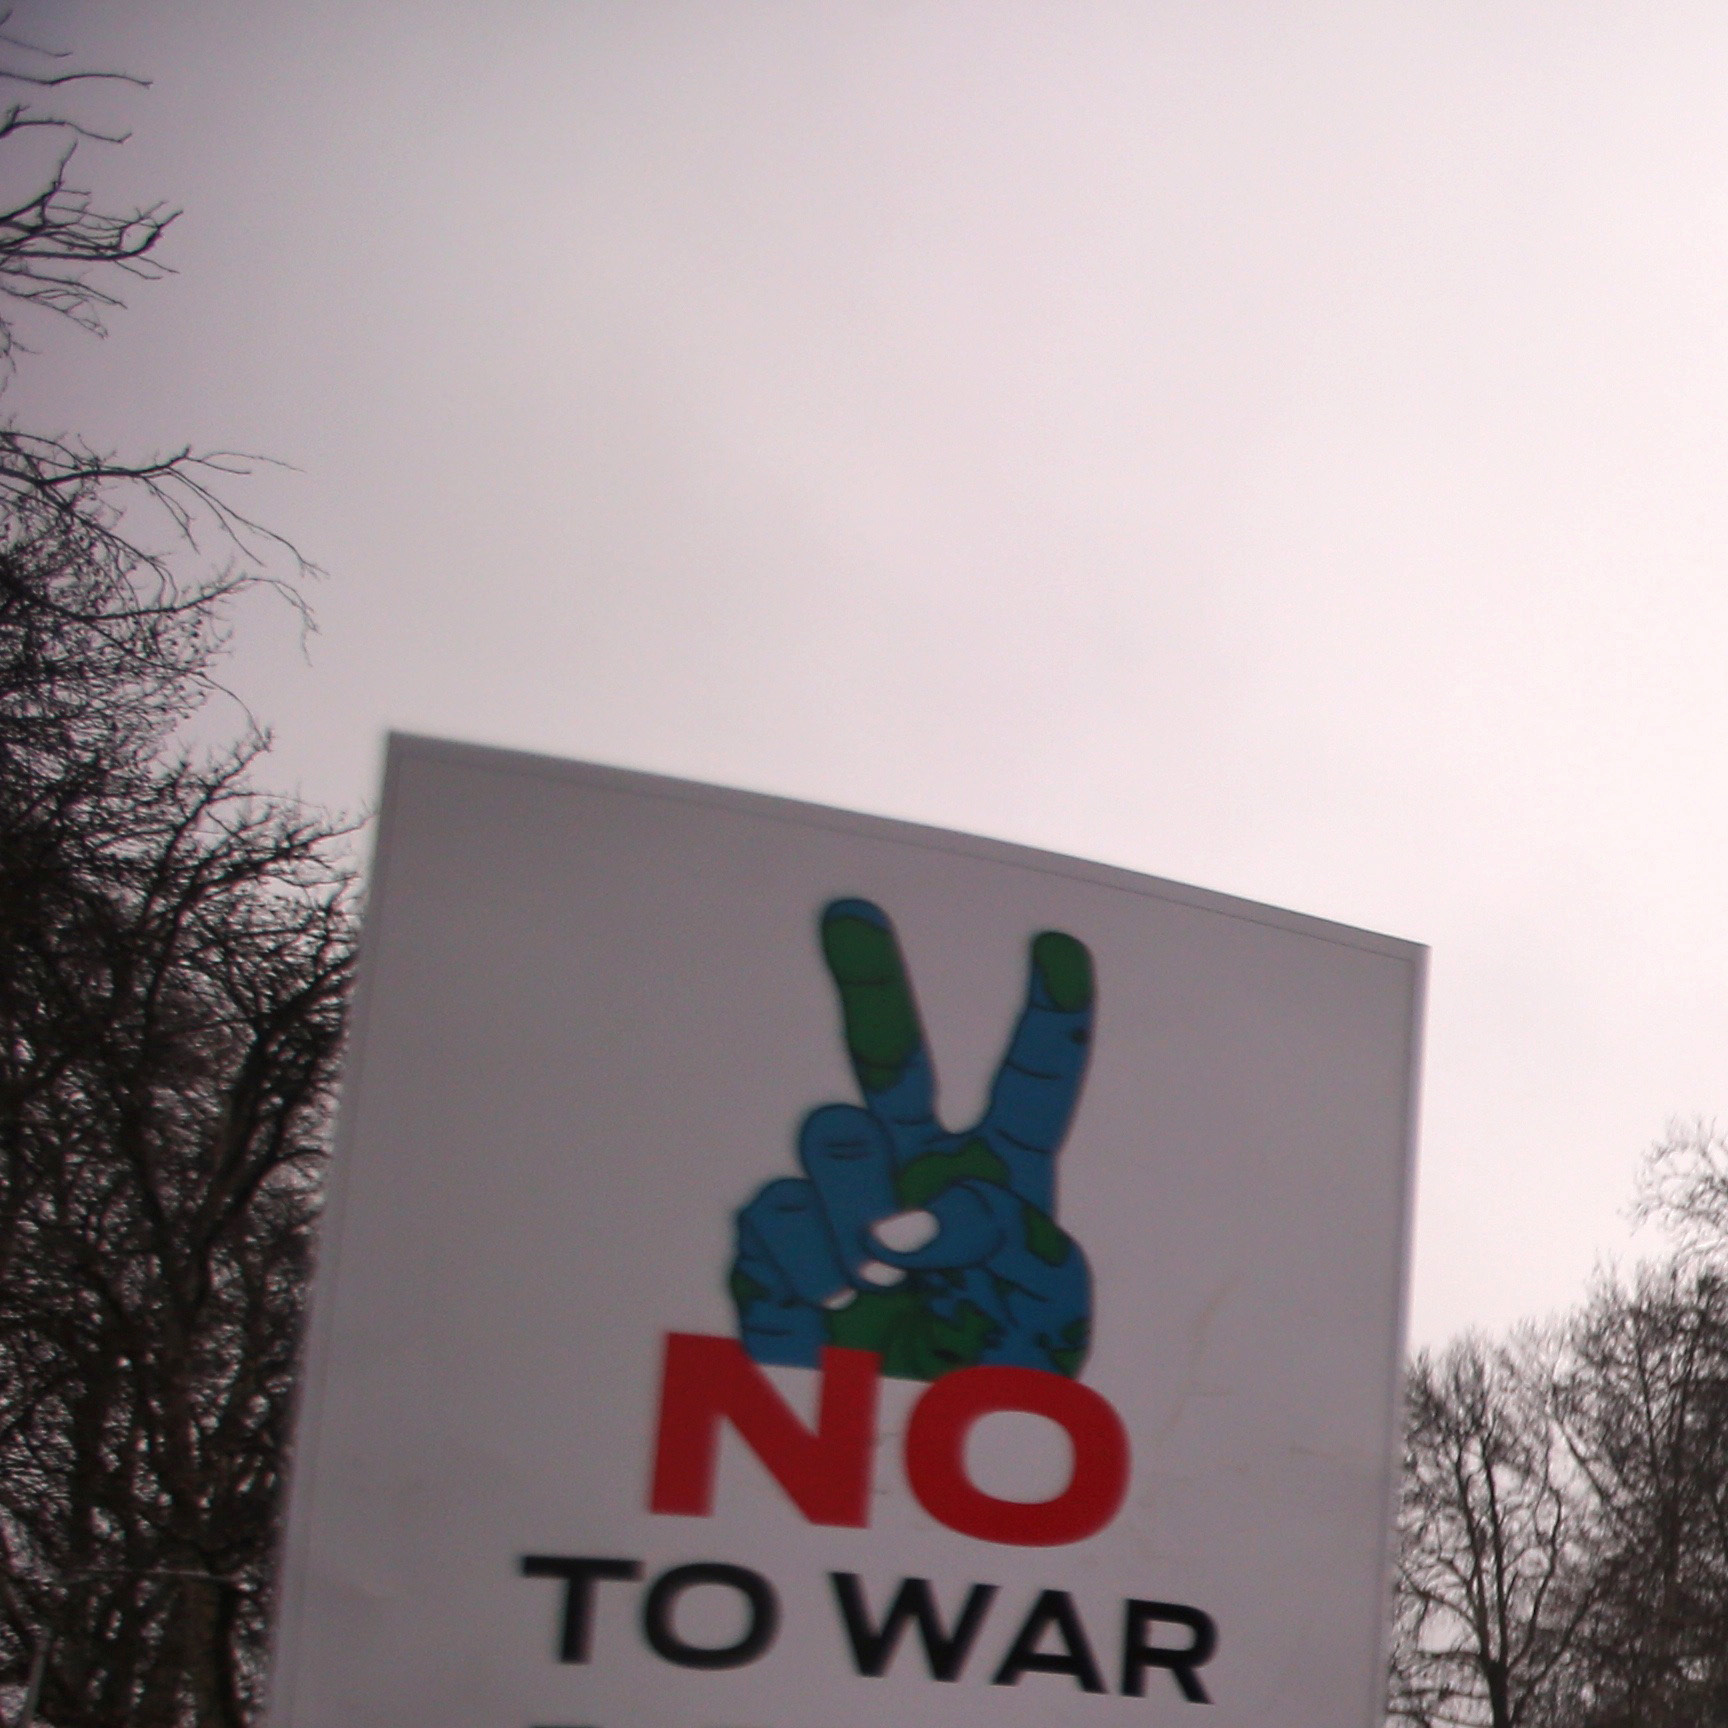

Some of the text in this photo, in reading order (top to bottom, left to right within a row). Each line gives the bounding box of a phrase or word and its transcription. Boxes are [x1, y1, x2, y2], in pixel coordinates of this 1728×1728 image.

[650, 1332, 1131, 1546] NO
[517, 1554, 1219, 1705] TO WAR
